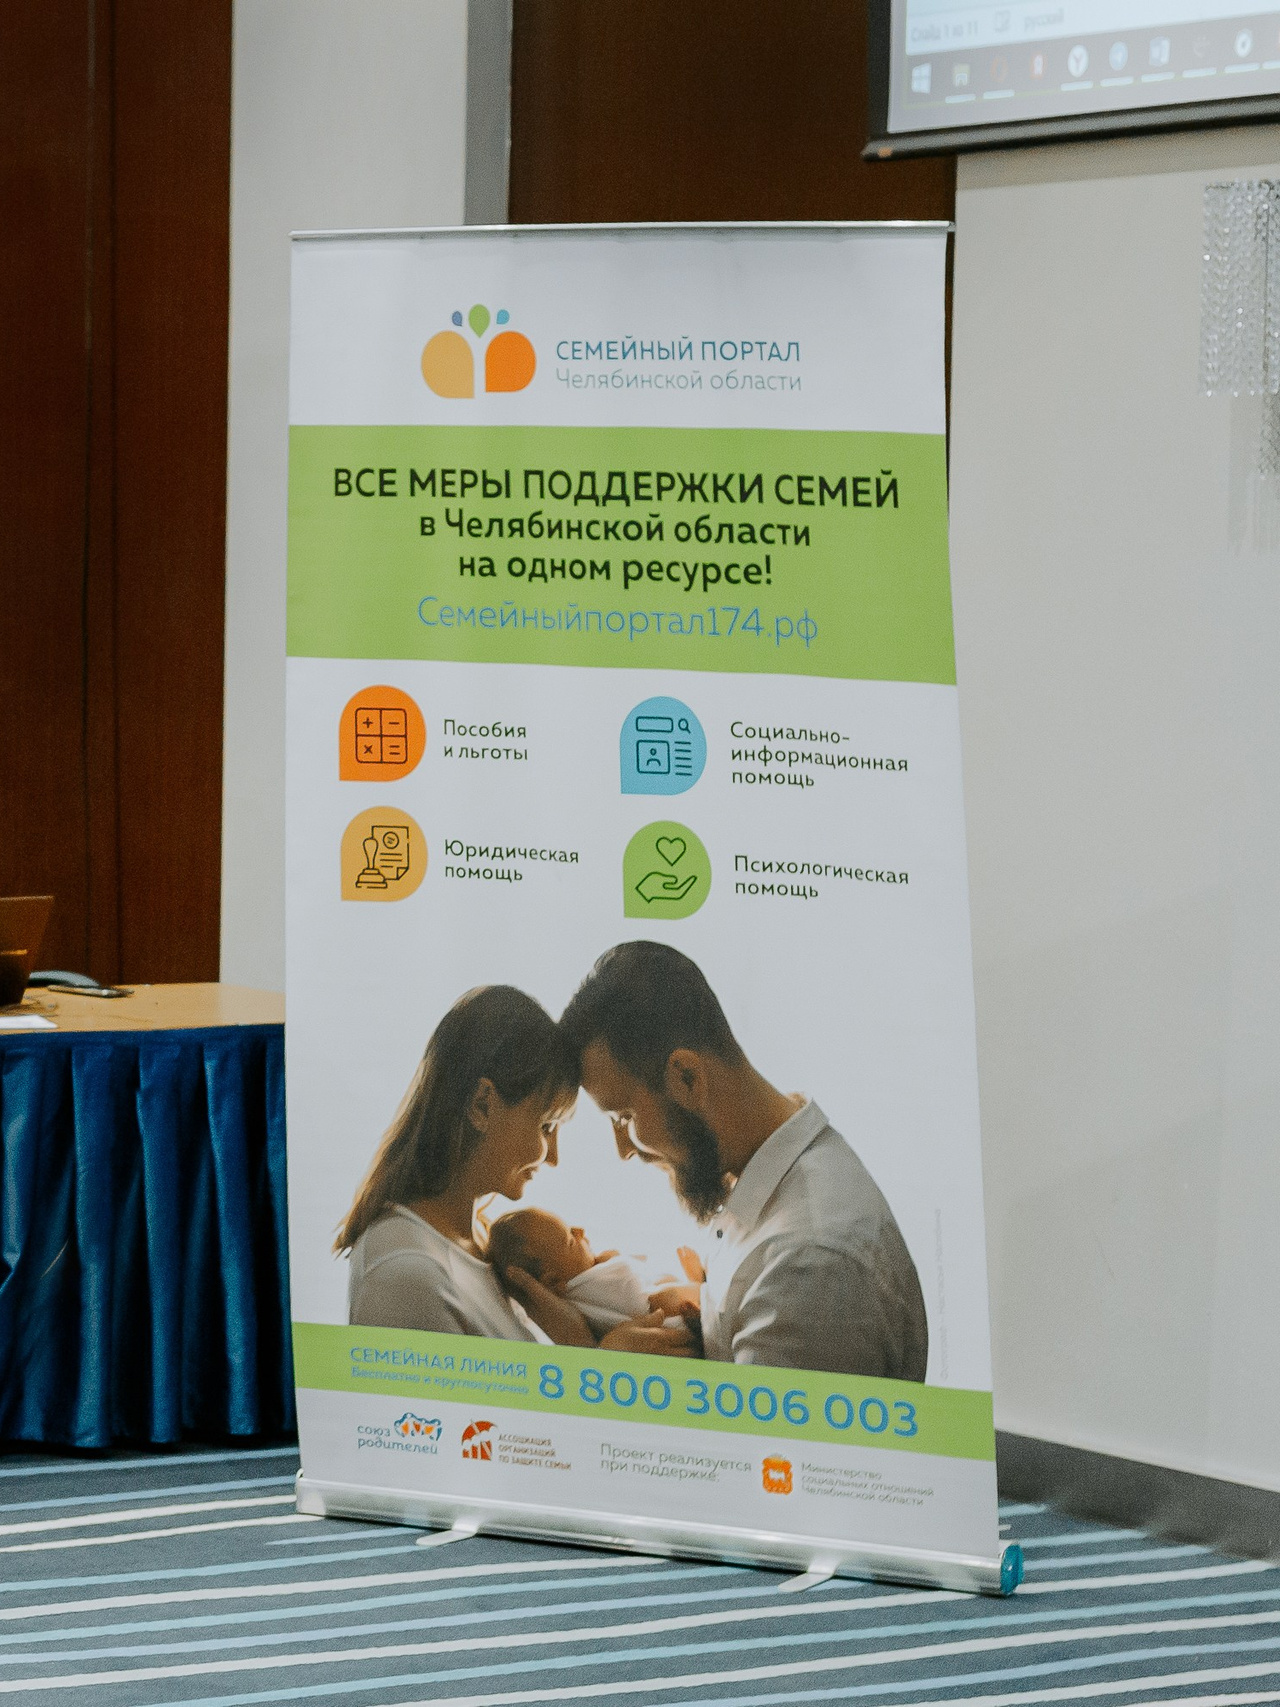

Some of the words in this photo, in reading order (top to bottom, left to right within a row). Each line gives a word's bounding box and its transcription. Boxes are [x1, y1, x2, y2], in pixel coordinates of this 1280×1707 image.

[556, 336, 693, 361] СЕМЕЙНЫЙ
[701, 341, 801, 361] ПОРТАЛ
[556, 368, 702, 390] Челябинской
[710, 370, 802, 391] области
[333, 468, 397, 497] ВСЕ
[410, 469, 511, 499] МЕРЫ
[523, 471, 764, 506] ПОДДЕРЖКИ
[774, 471, 899, 508] СЕМЕЙ
[421, 516, 436, 536] в
[445, 509, 664, 542] Челябинской
[674, 515, 811, 546] области
[459, 556, 496, 577] на
[507, 556, 611, 583] одном
[623, 556, 773, 592] ресурсе!
[417, 596, 818, 648] Семейныйпортал174.рф
[443, 719, 527, 739] Пособия
[730, 721, 850, 745] Социально-
[443, 745, 454, 758] и
[458, 745, 528, 761] льготы
[730, 744, 909, 773] информационная
[731, 771, 815, 789] помощь
[444, 839, 580, 864] Юридическая
[445, 864, 523, 884] помощь
[734, 856, 909, 885] Психологическая
[735, 881, 819, 899] помощь
[350, 1346, 455, 1371] СЕМЕЙНАЯ
[460, 1357, 528, 1379] ЛИНИЯ
[538, 1364, 565, 1400] 8
[579, 1368, 672, 1411] 800
[686, 1379, 810, 1427] 3006
[824, 1393, 919, 1438] 003
[357, 1425, 391, 1437] союз
[358, 1436, 438, 1454] родителей
[601, 1444, 654, 1464] Проект
[659, 1452, 752, 1473] реализуется
[601, 1460, 628, 1476] при
